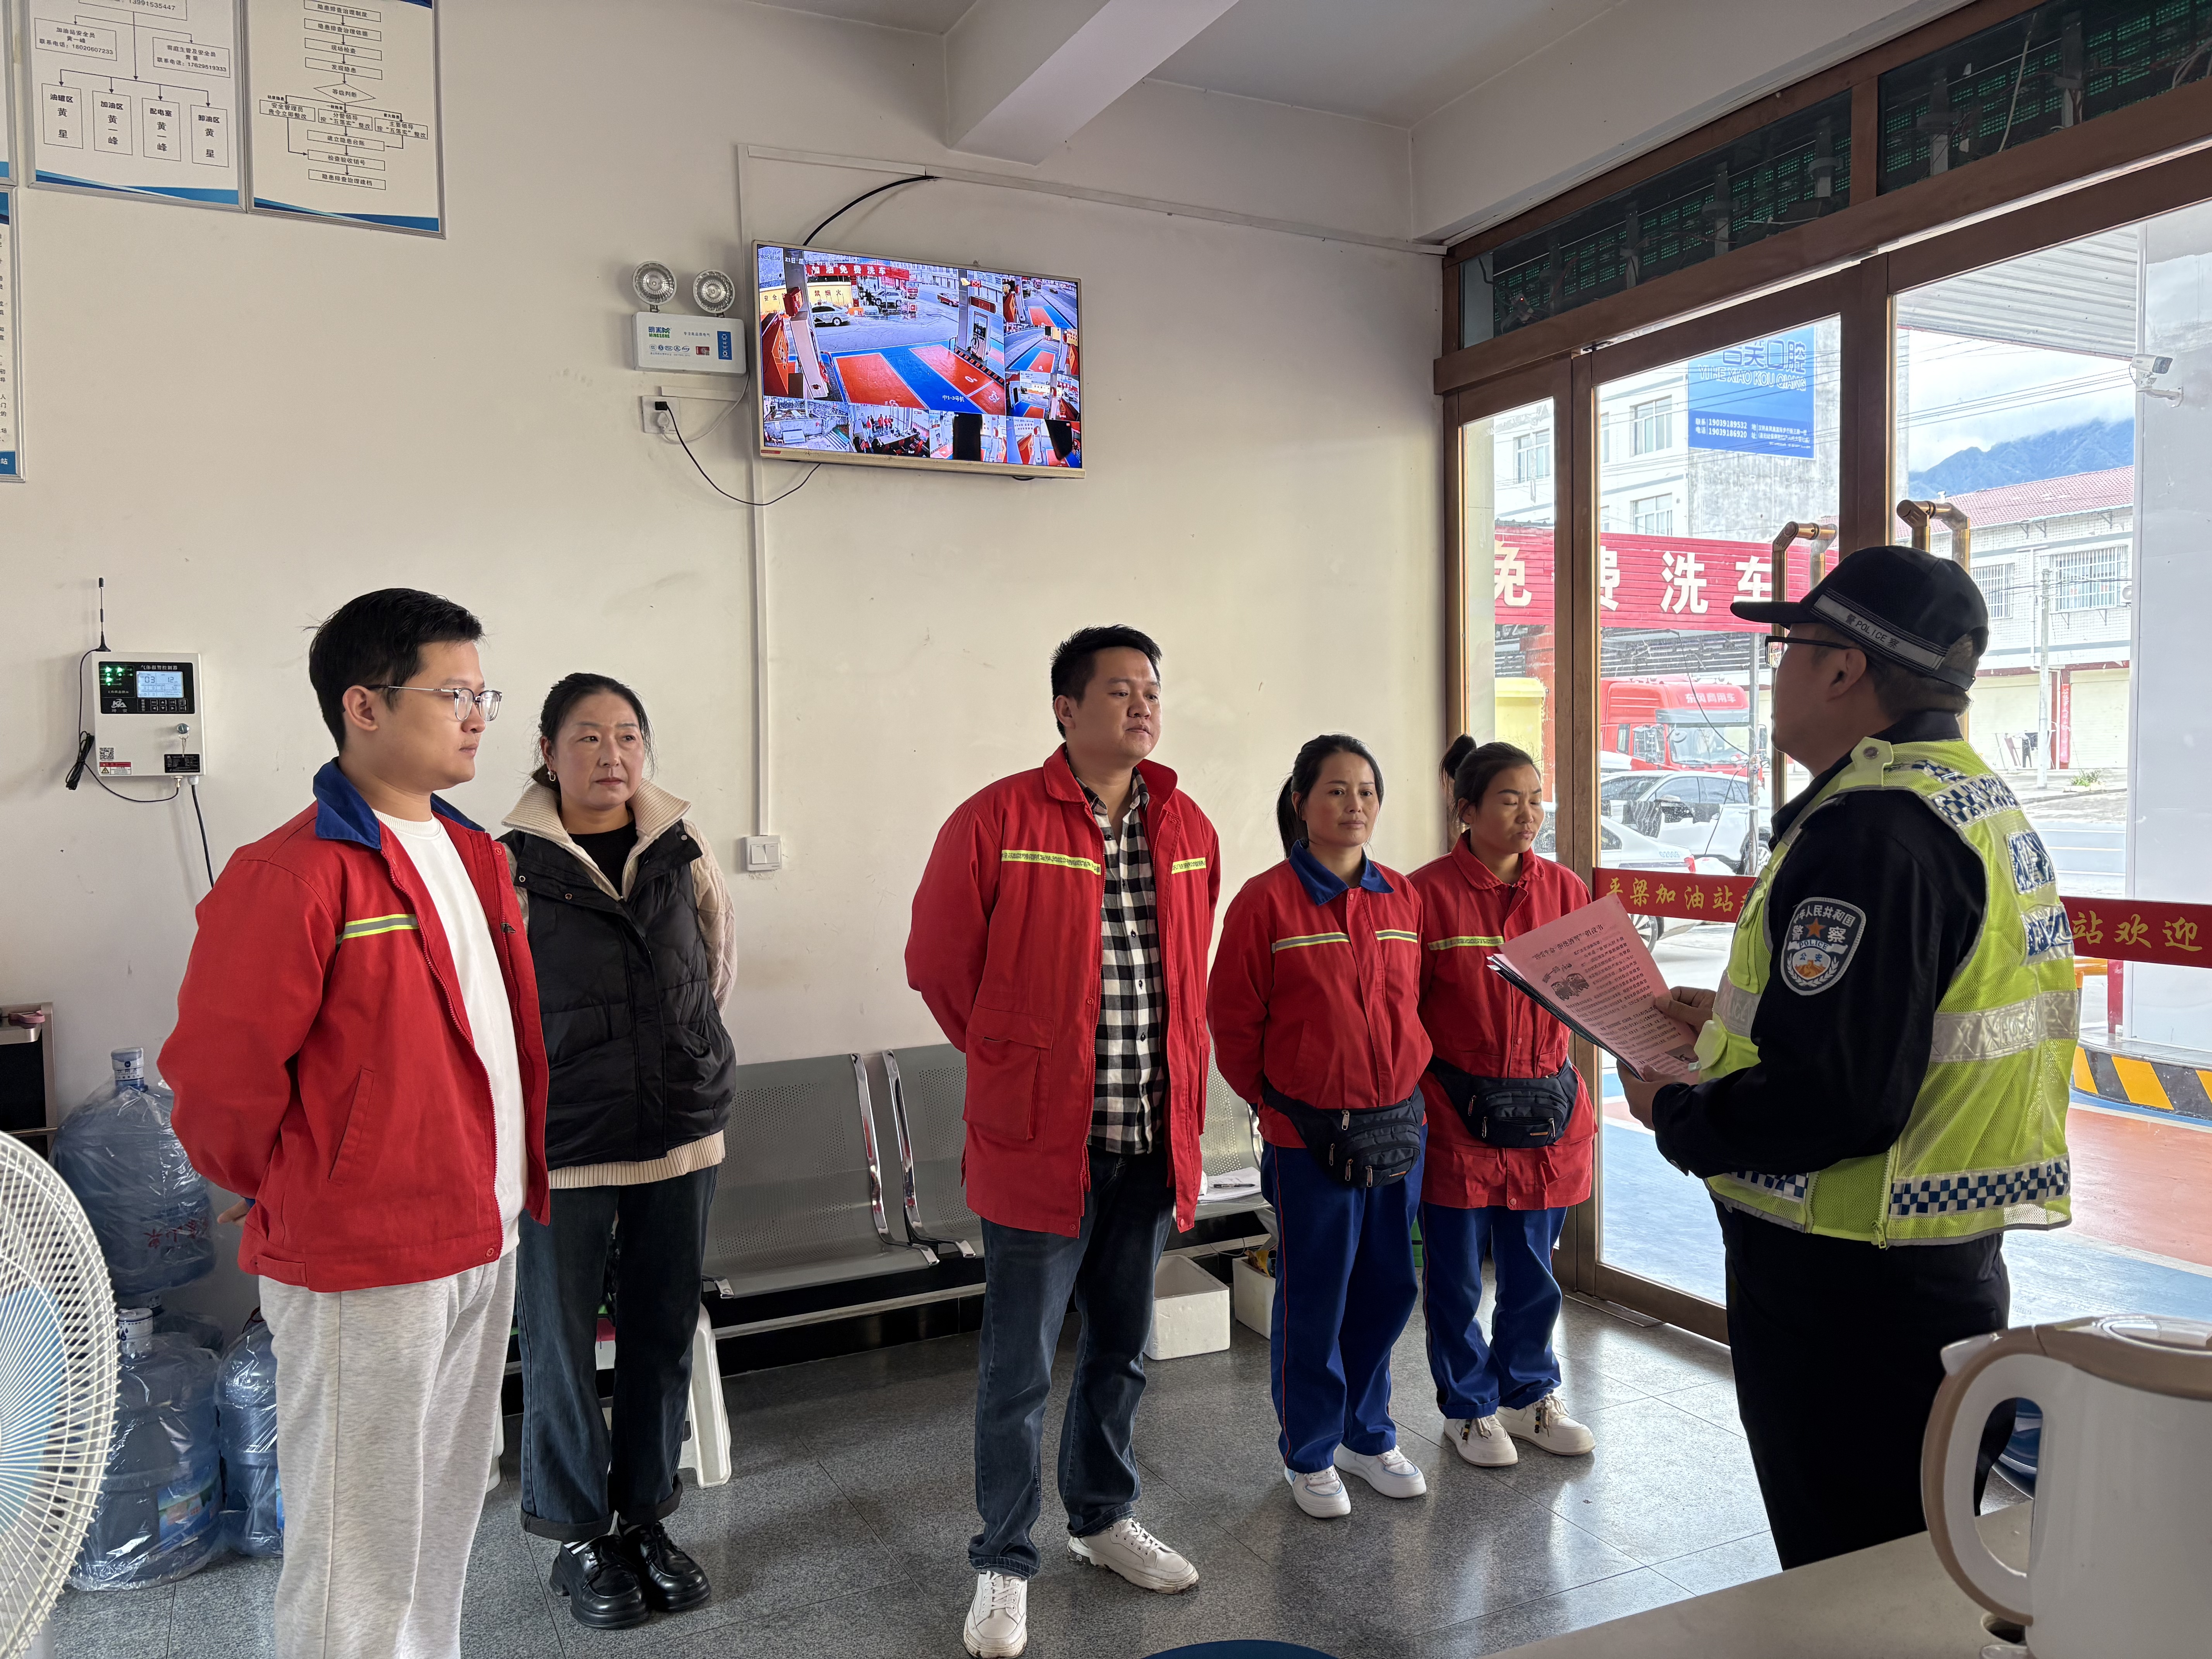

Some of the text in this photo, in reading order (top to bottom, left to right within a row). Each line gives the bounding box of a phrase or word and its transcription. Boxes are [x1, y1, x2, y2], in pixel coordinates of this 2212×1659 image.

[331, 45, 356, 54] 现场检查
[50, 93, 74, 103] 油罐区
[332, 89, 357, 98] 等级判断
[101, 101, 124, 110] 加油区
[271, 103, 303, 112] 安全管理员
[150, 108, 172, 117] 配电室
[198, 115, 220, 124] 卸油区
[389, 121, 414, 130] 主要领导
[1753, 370, 1775, 387] KOU
[1709, 418, 1747, 429] 19039189532
[1709, 428, 1747, 438] 19039186920
[1855, 620, 1888, 642] POLICE
[1887, 638, 1899, 649] 察
[1685, 693, 1736, 703] 东风商用车
[1606, 877, 1748, 913] 平梁加油站
[2072, 910, 2203, 951] 站欢迎
[1800, 939, 1829, 950] POLICE
[1800, 952, 1823, 962] 公安
